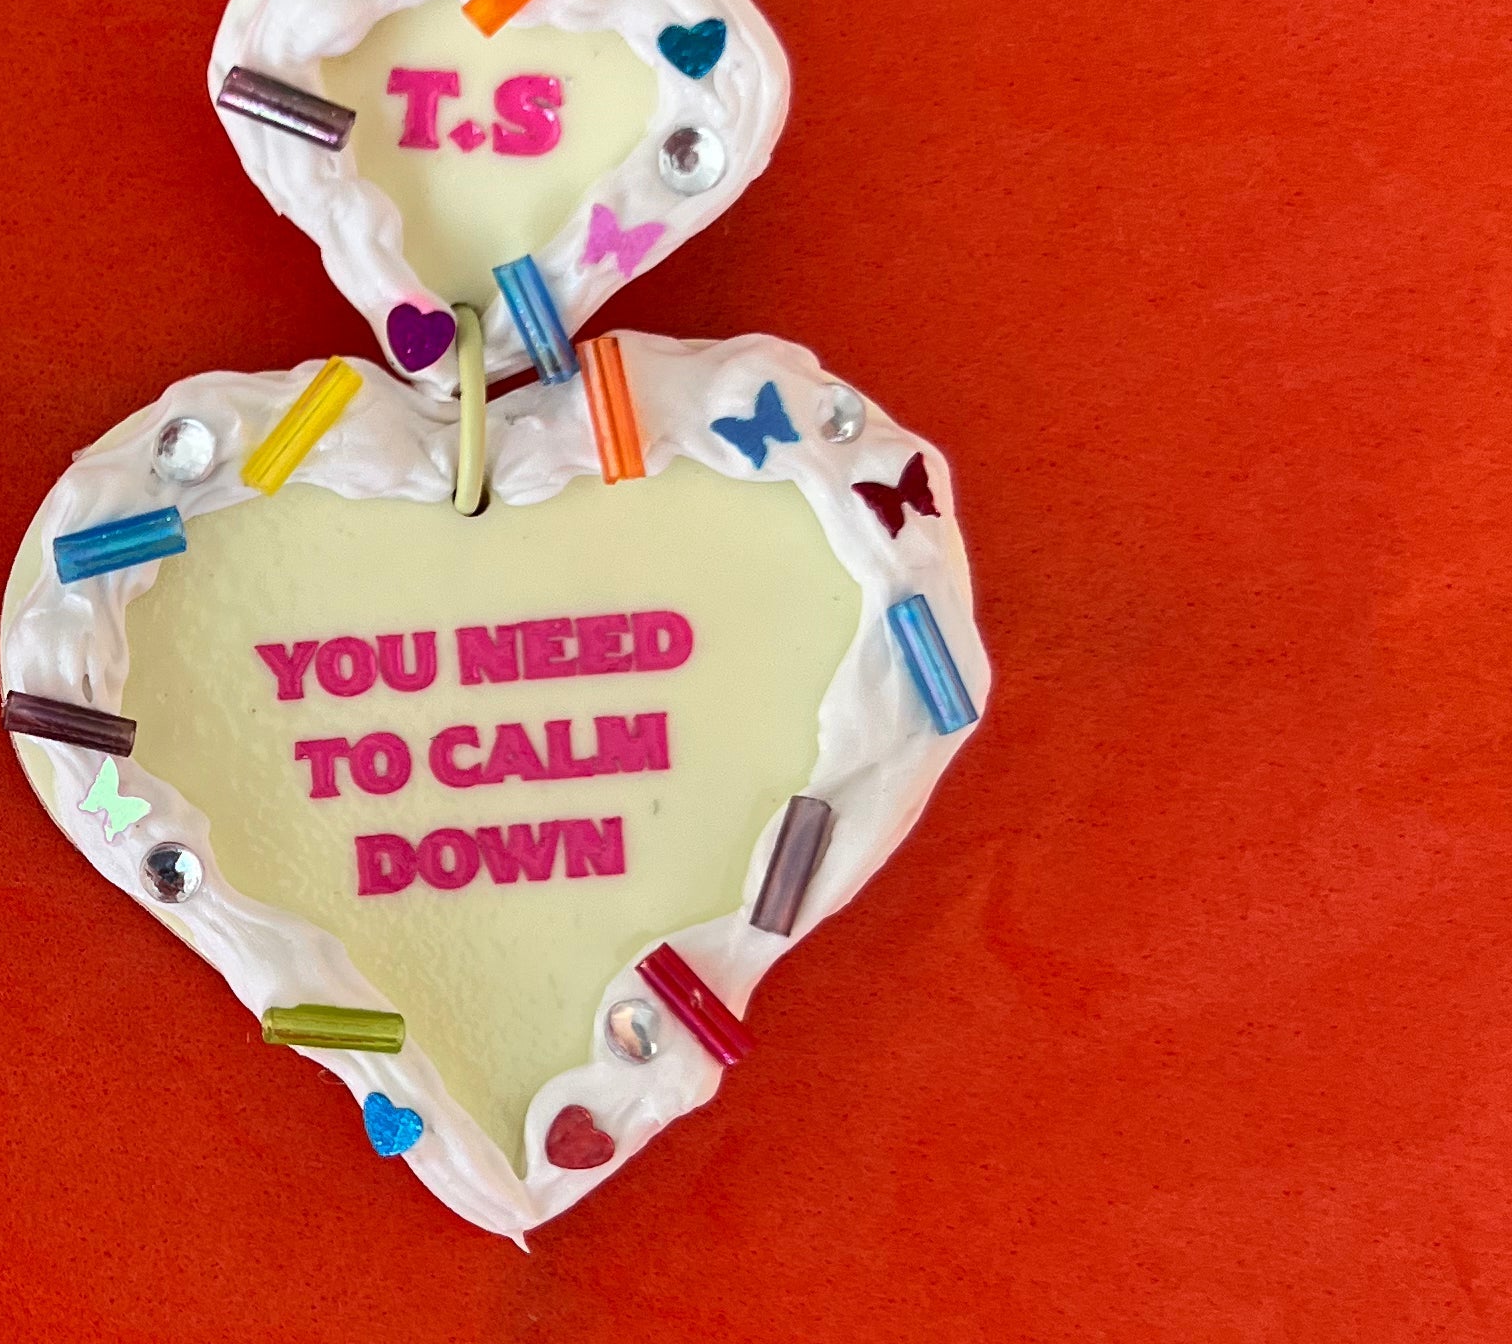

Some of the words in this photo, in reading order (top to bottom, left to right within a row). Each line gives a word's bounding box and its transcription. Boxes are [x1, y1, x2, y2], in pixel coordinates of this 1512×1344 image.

[385, 67, 563, 157] T.S
[255, 630, 438, 702] YOU
[455, 610, 695, 686] NEED
[294, 731, 413, 800] TO
[428, 711, 671, 789] CALM
[355, 816, 627, 897] DOWN
